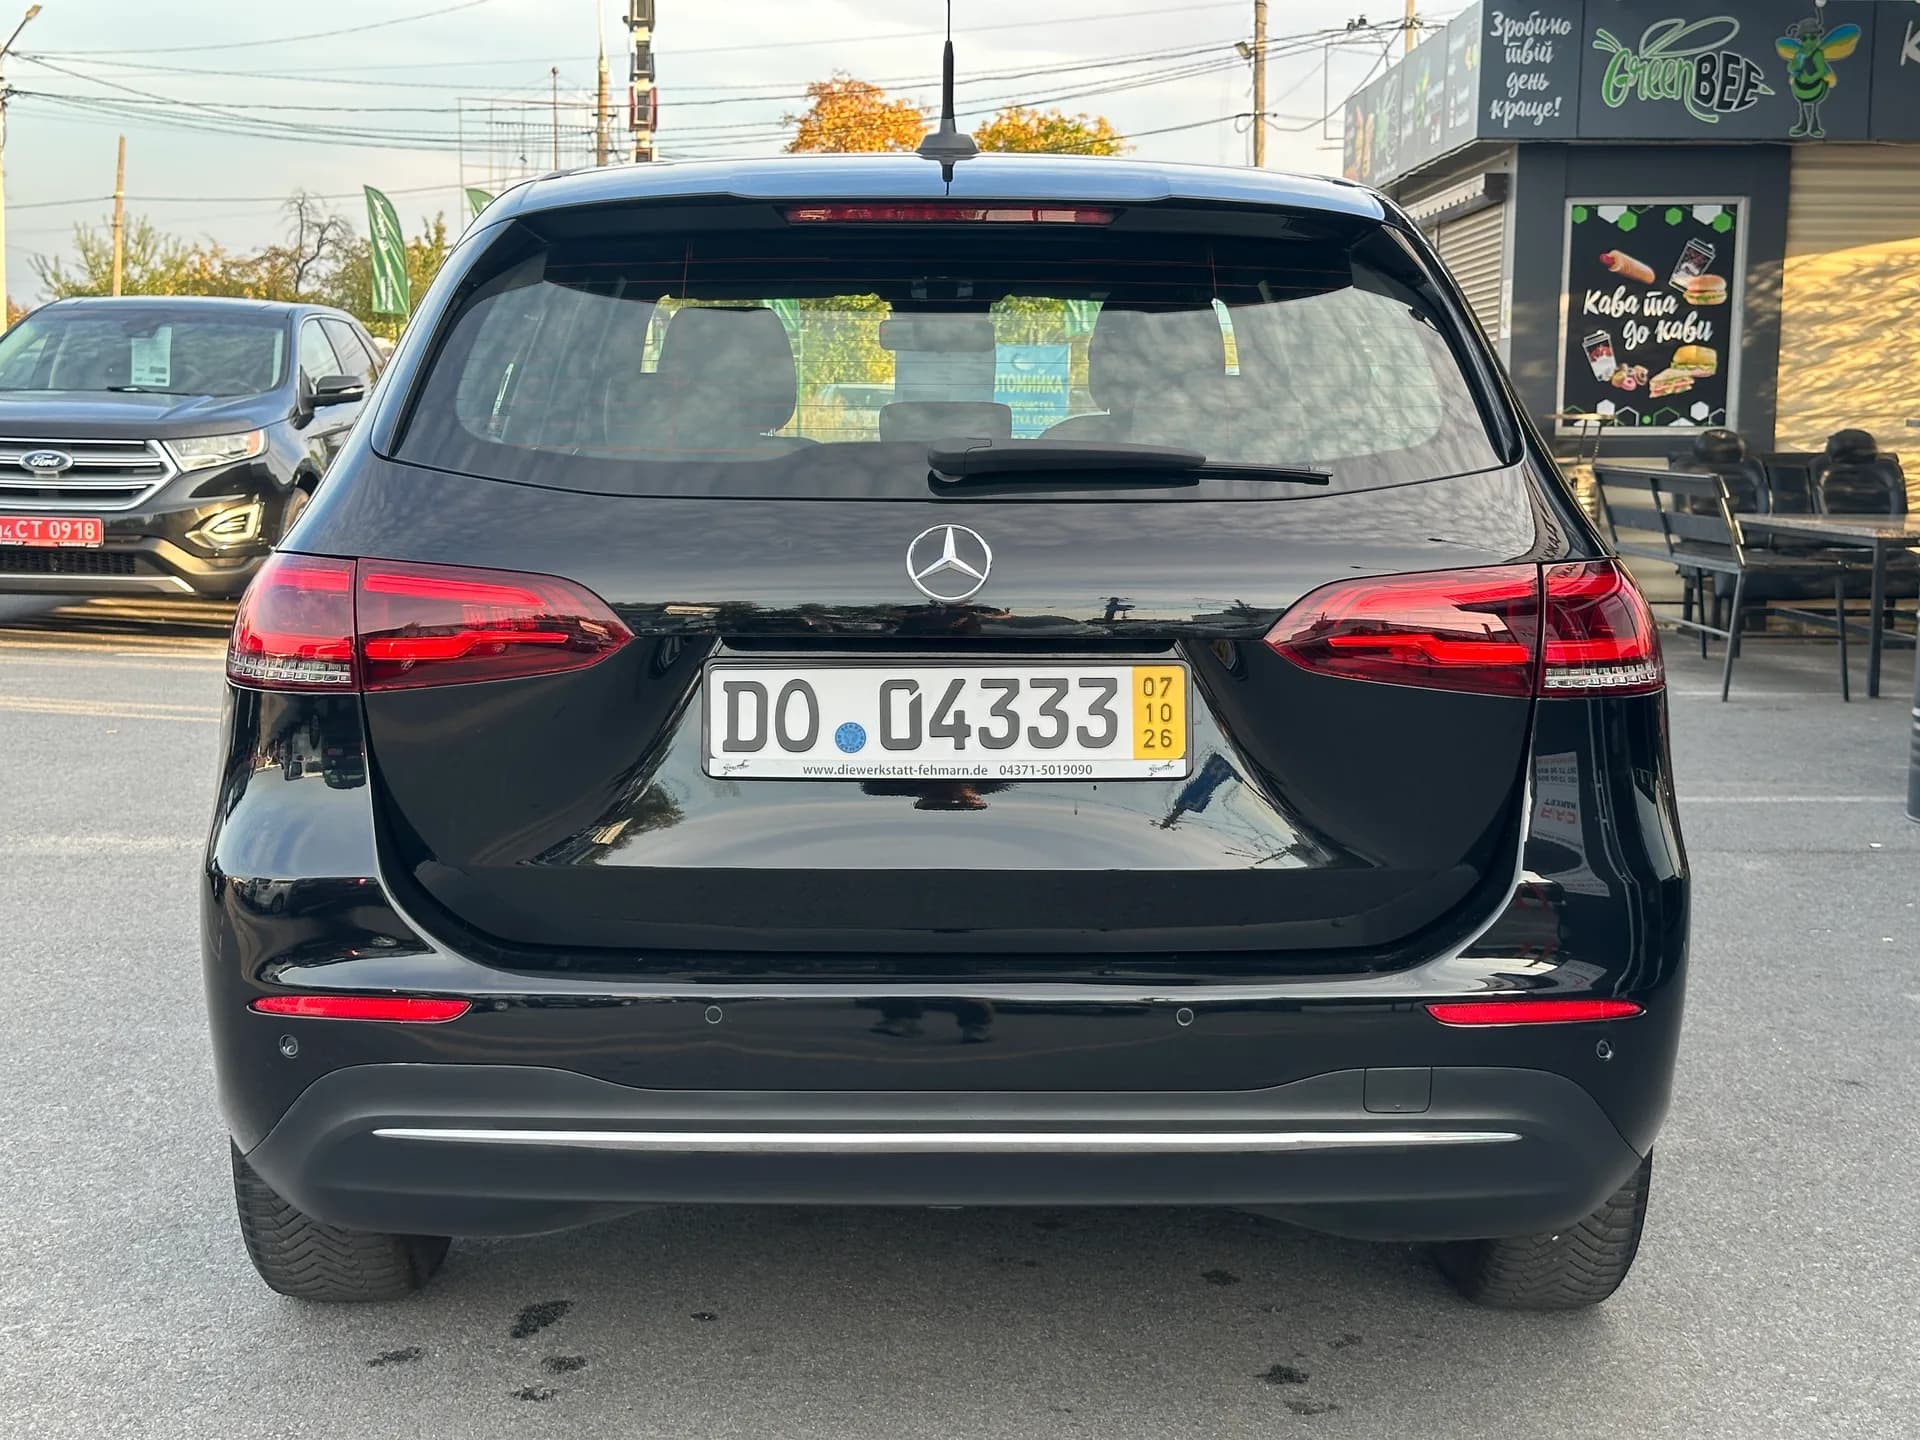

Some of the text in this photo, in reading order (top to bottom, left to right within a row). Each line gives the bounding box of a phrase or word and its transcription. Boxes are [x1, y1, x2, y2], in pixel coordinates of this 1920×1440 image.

[1505, 37, 1554, 64] твій
[1506, 71, 1550, 98] день
[1489, 96, 1562, 129] краще!
[1583, 285, 1678, 318] Кава та
[1622, 311, 1713, 351] до кави
[994, 368, 1064, 393] ТОМИЙКА
[30, 454, 60, 467] Ford
[49, 521, 95, 540] 0918
[1143, 677, 1172, 697] 07
[722, 678, 820, 753] DO
[879, 677, 1119, 752] 04333
[1146, 703, 1172, 722] 10
[1143, 729, 1172, 748] 26
[803, 764, 1093, 776] www.diewerkstatt-fehmarn.de 04371-5019090
